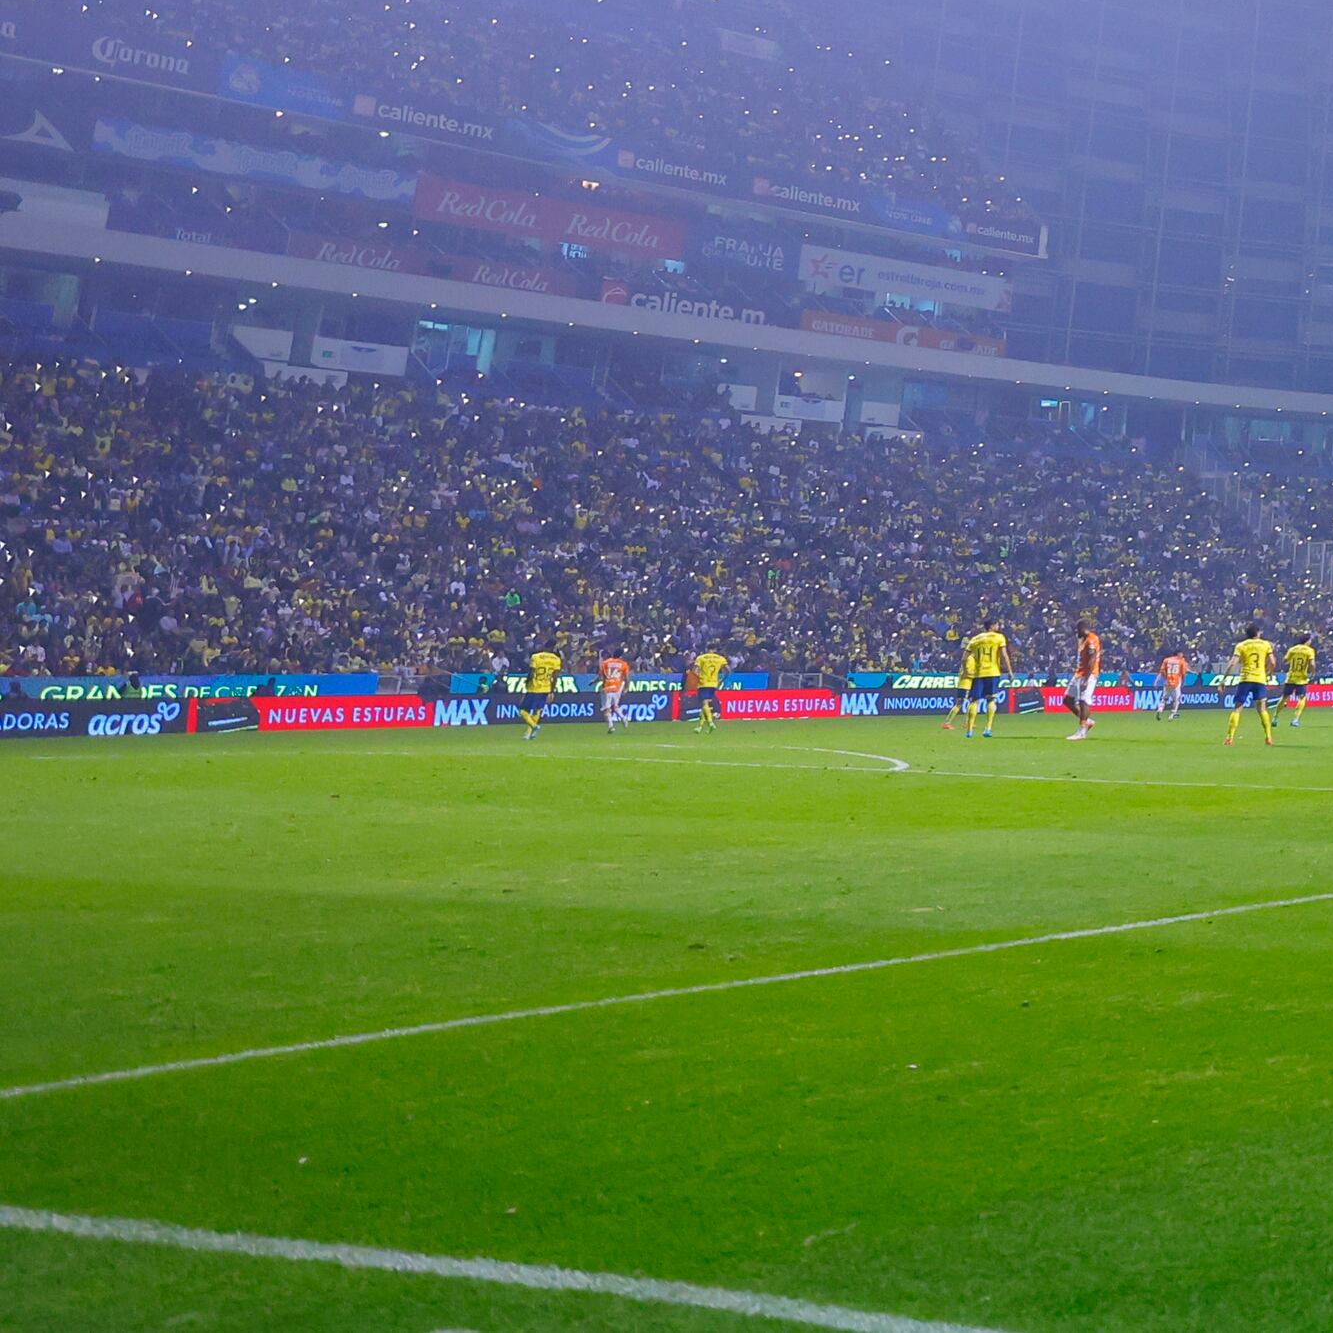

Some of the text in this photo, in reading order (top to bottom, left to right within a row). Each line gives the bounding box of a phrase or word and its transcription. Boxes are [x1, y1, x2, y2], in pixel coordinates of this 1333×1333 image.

[91, 35, 190, 75] Corona
[377, 102, 496, 141] caliente.mx
[635, 154, 728, 187] caliente.mx
[976, 226, 1036, 245] caliente.mx
[631, 291, 776, 327] caliente.m
[812, 319, 876, 339] GATORADE
[976, 646, 994, 664] 14
[726, 697, 836, 713] NUEVAS ESTUFAS
[840, 692, 880, 716] MAX
[883, 696, 955, 710] INNOVADORAS
[1133, 690, 1164, 710] MAX
[268, 705, 427, 724] NUEVAS ESTUFAS
[433, 698, 490, 727] MAX
[87, 715, 162, 736] acros
